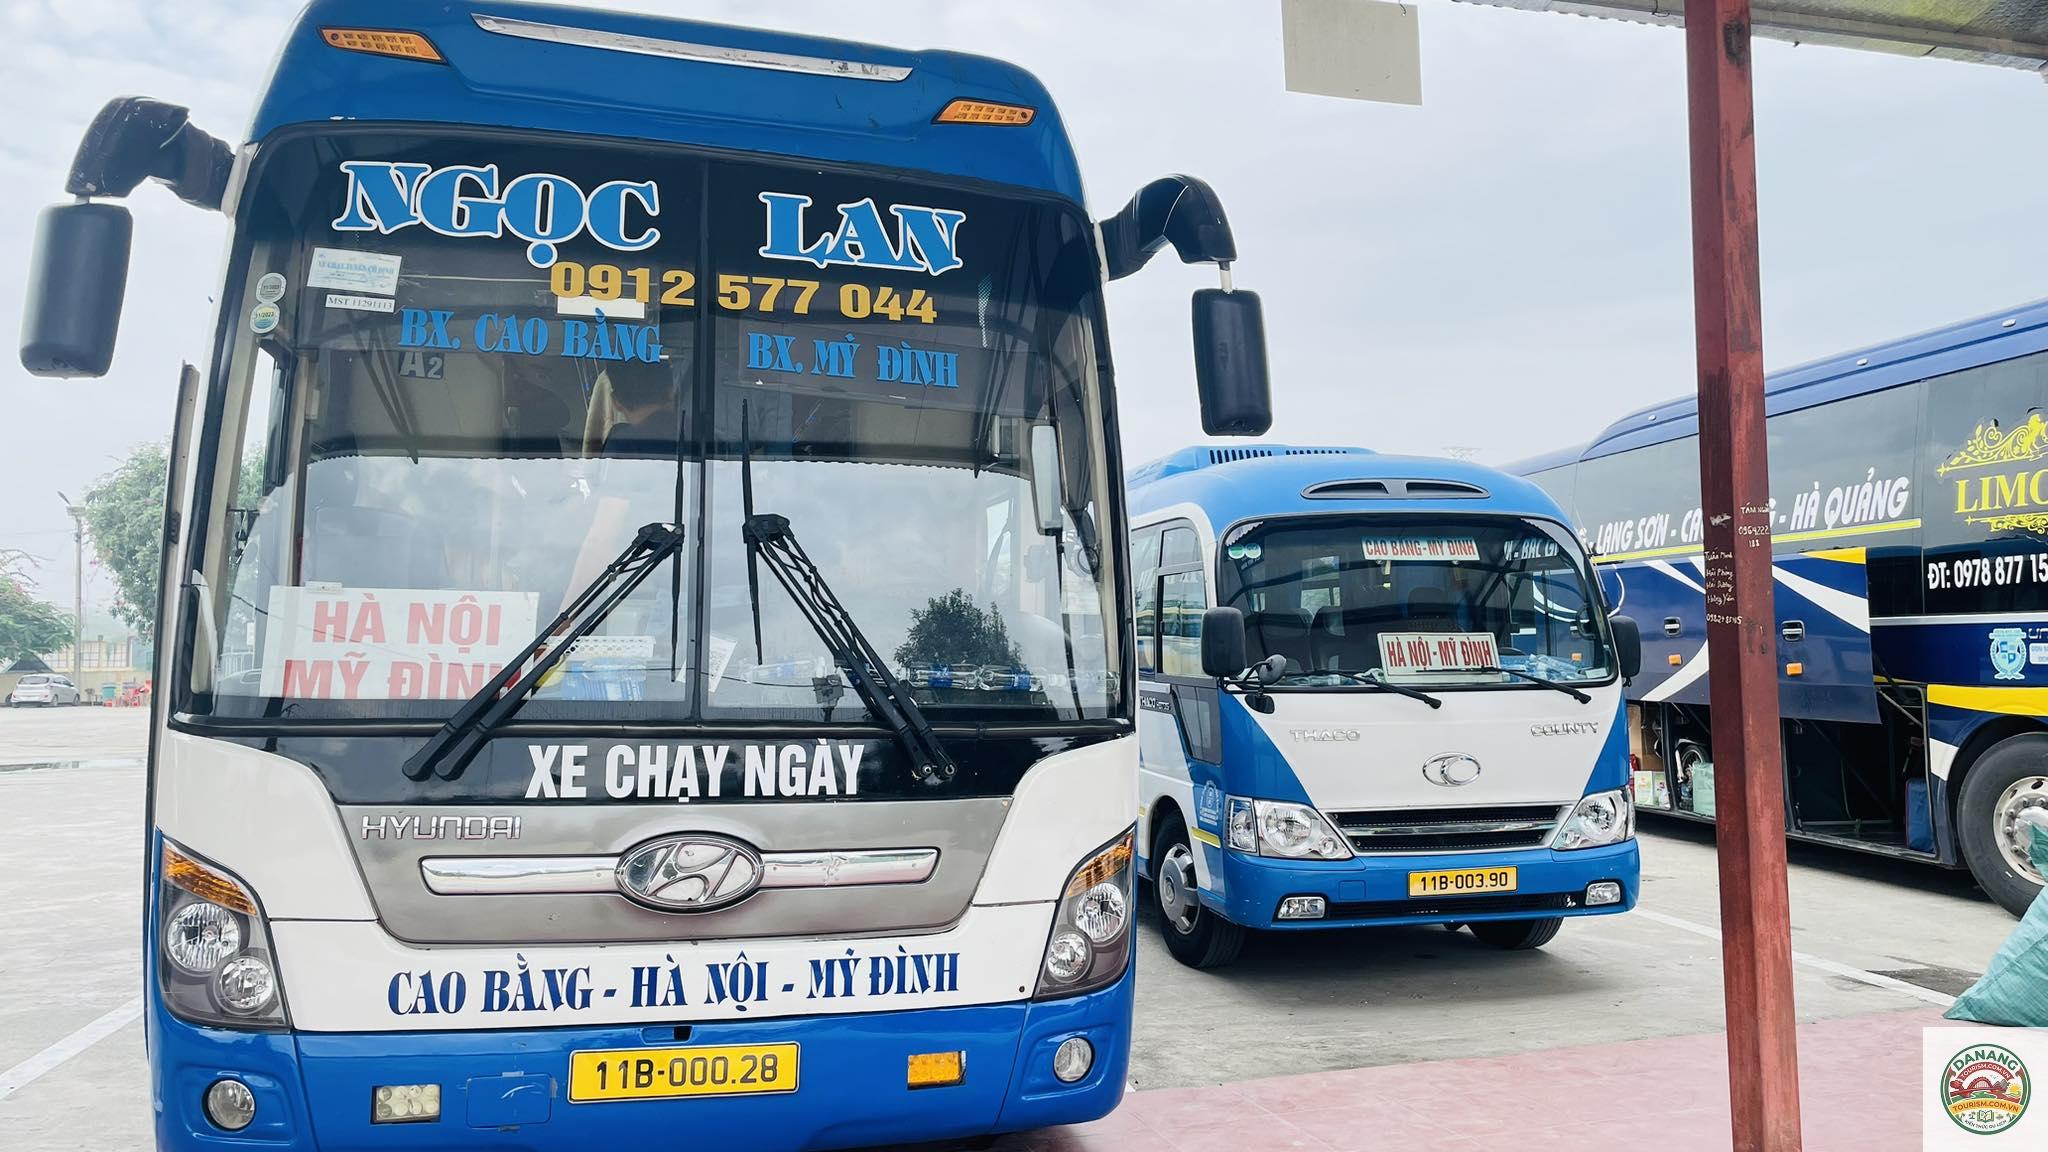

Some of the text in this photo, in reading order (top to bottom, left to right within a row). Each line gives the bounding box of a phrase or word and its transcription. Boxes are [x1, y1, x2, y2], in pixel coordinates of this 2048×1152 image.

[332, 160, 966, 276] NGỌC LAN
[328, 297, 350, 305] MST
[551, 262, 938, 324] 0912 577 044
[398, 307, 664, 364] BX. CAO BẰNG
[747, 332, 803, 373] BX.
[876, 341, 960, 388] ĐÌNH
[1790, 481, 1821, 531] HÀ
[1824, 467, 1910, 531] QUẢNG
[1365, 539, 1388, 556] CAO
[1596, 519, 1634, 558] LẠNG
[1634, 512, 1670, 550] SƠN
[1681, 508, 1704, 543] CA
[1928, 562, 1951, 589] ĐT:
[1954, 558, 1992, 589] 0978
[1995, 555, 2024, 586] 877
[312, 592, 502, 655] HÀ NỘI
[283, 651, 370, 700] MỸ
[1387, 636, 1406, 667] HÀ
[1460, 636, 1493, 667] ĐÌNH
[1290, 728, 1360, 742] THACO
[1531, 722, 1599, 737] COUNTY
[525, 738, 865, 802] XE CHẠY NGÀY
[361, 815, 522, 840] HYUNDAI
[1421, 872, 1508, 891] 11B-003.90
[388, 970, 467, 1016] CAO
[481, 953, 594, 1012] BẰNG
[630, 954, 688, 1008] HÀ
[704, 950, 769, 1013] NỘI
[868, 945, 960, 996] ĐÌNH
[597, 1054, 778, 1090] 11B-000.28
